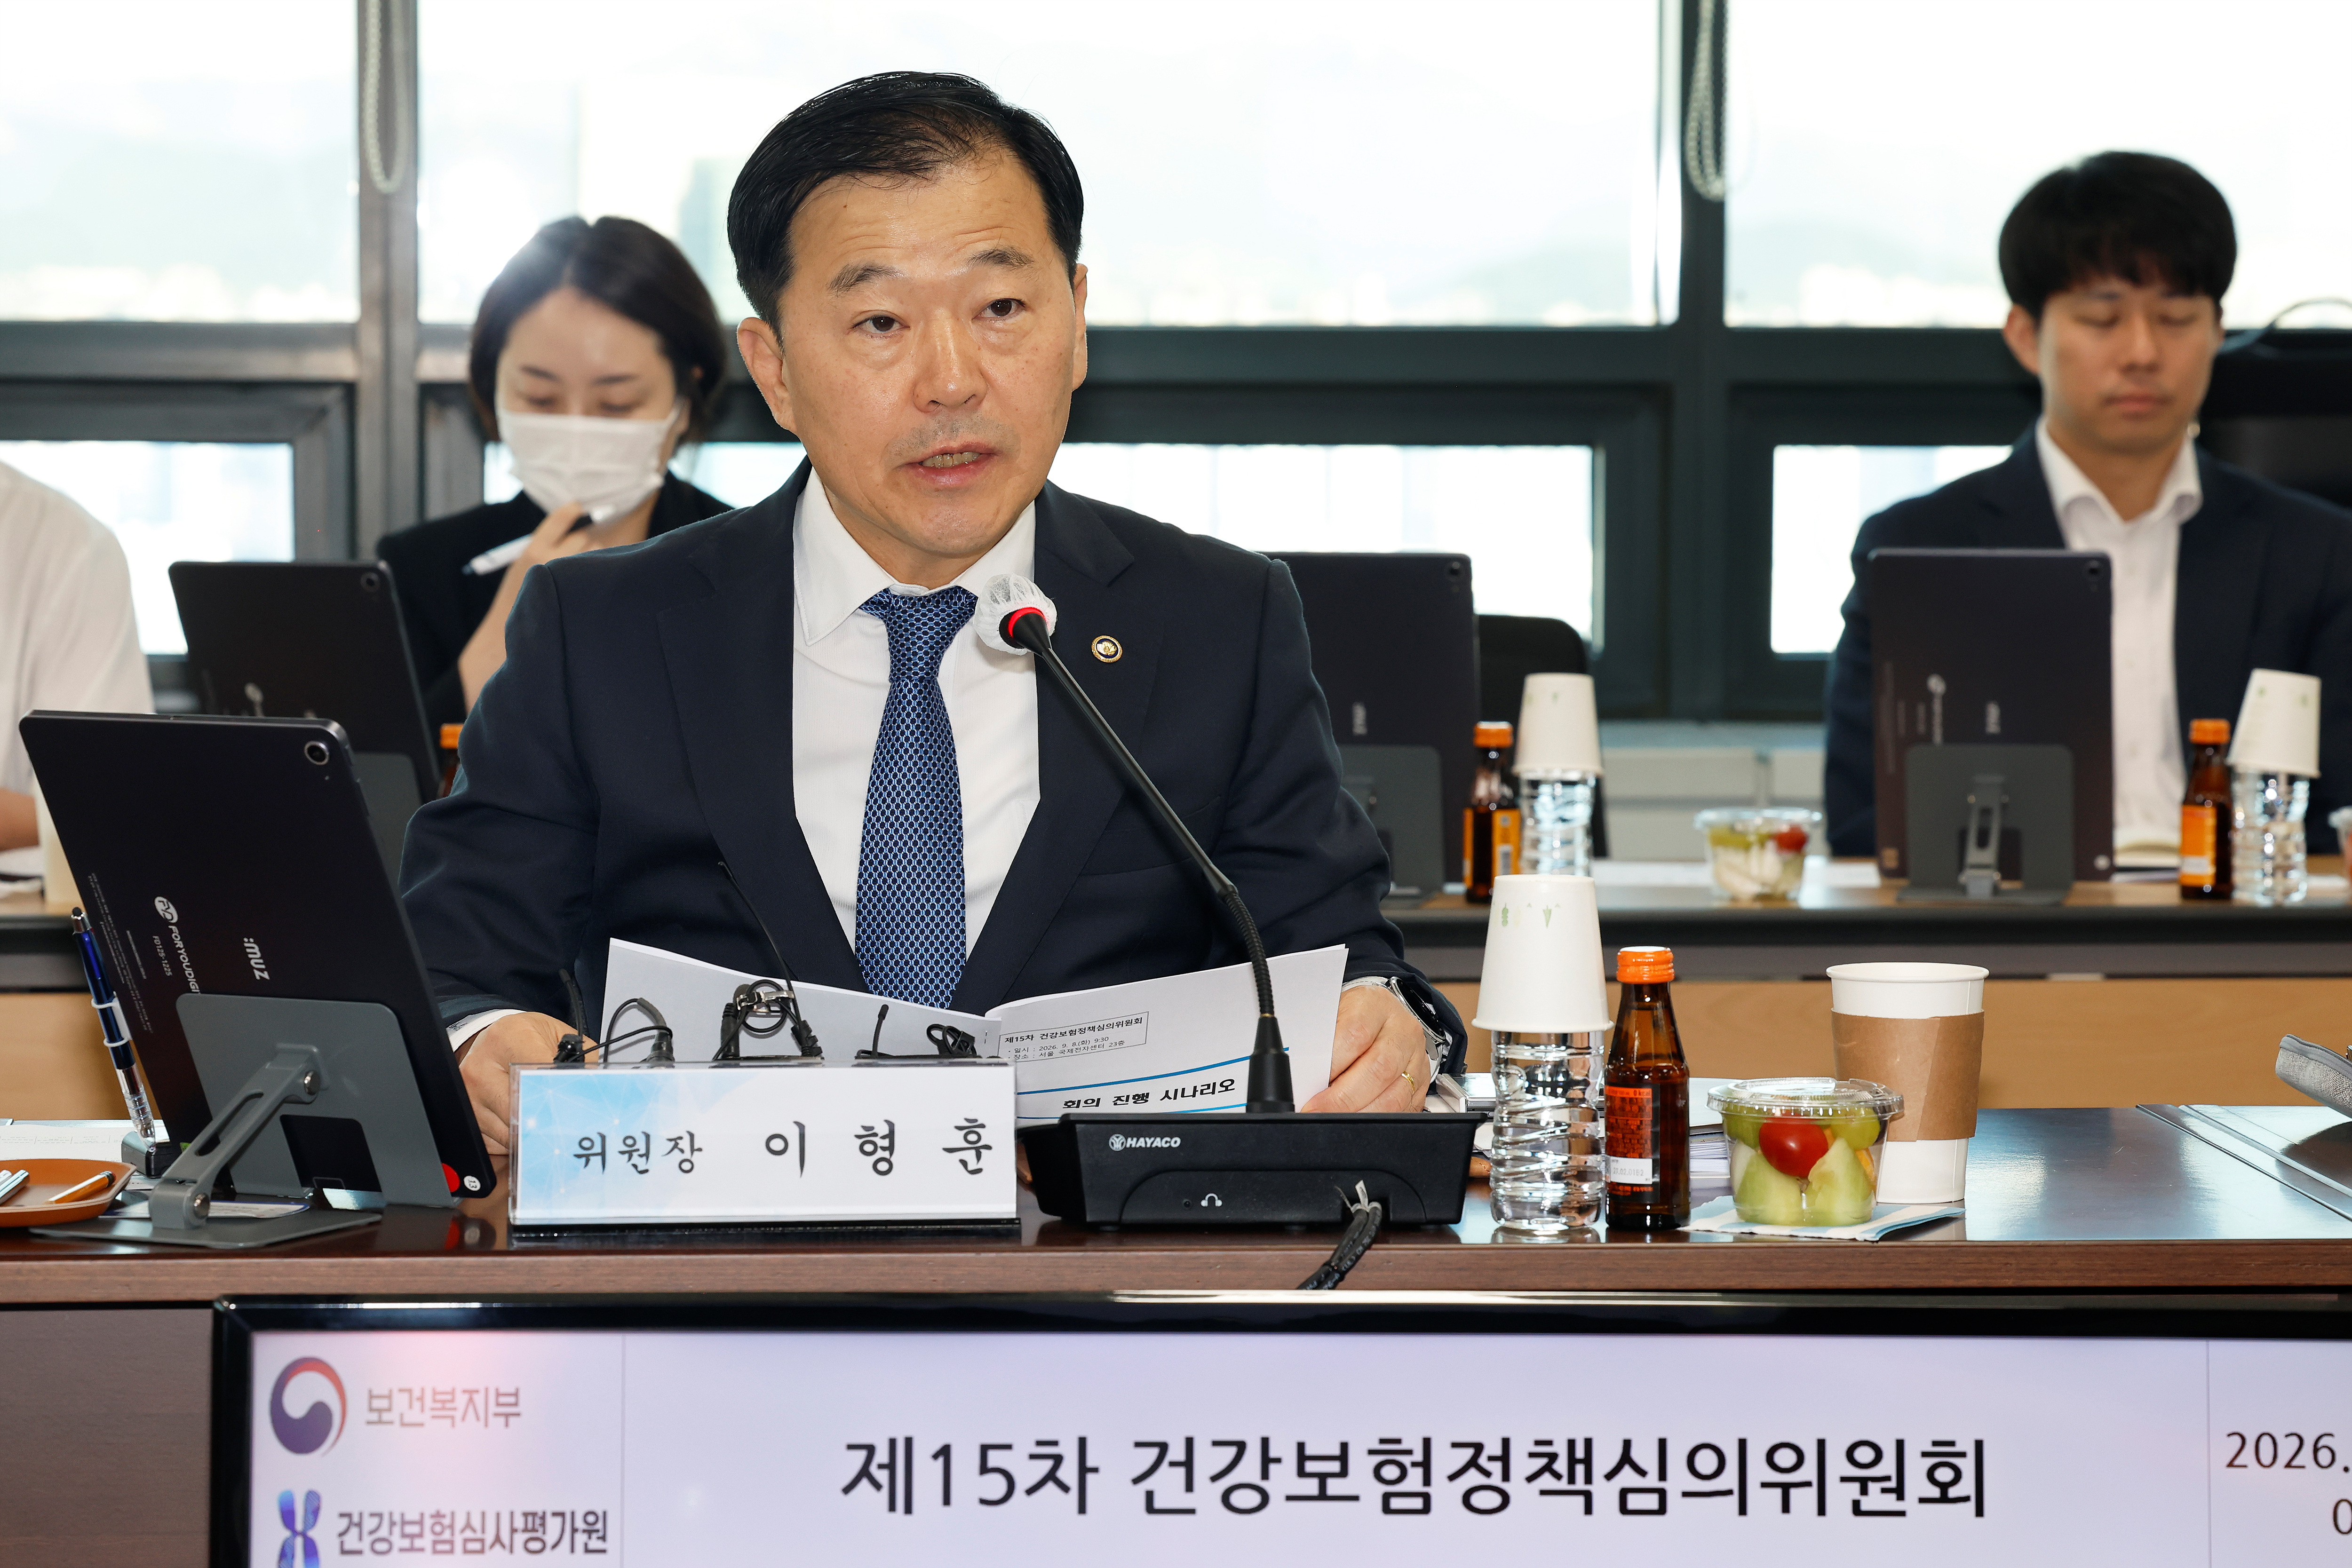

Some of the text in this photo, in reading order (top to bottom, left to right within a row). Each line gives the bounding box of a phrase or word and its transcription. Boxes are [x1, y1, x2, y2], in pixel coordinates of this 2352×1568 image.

[168, 925, 201, 994] FORYOUDIGI
[1005, 1017, 1143, 1043] 제15차 건강보험정책심의위원회
[1058, 1043, 1105, 1054] 국제전자센터
[1062, 1078, 1236, 1109] 회의 진행 시나리오
[573, 1117, 993, 1177] 위원장 이 형 훈
[1125, 1137, 1181, 1148] HAYACO
[366, 1386, 522, 1428] 보건복지부
[2226, 1432, 2350, 1473] 2026.
[841, 1436, 1985, 1519] 제15차 건강보험정책심의위원회
[338, 1510, 608, 1555] 건강보험심사평가원
